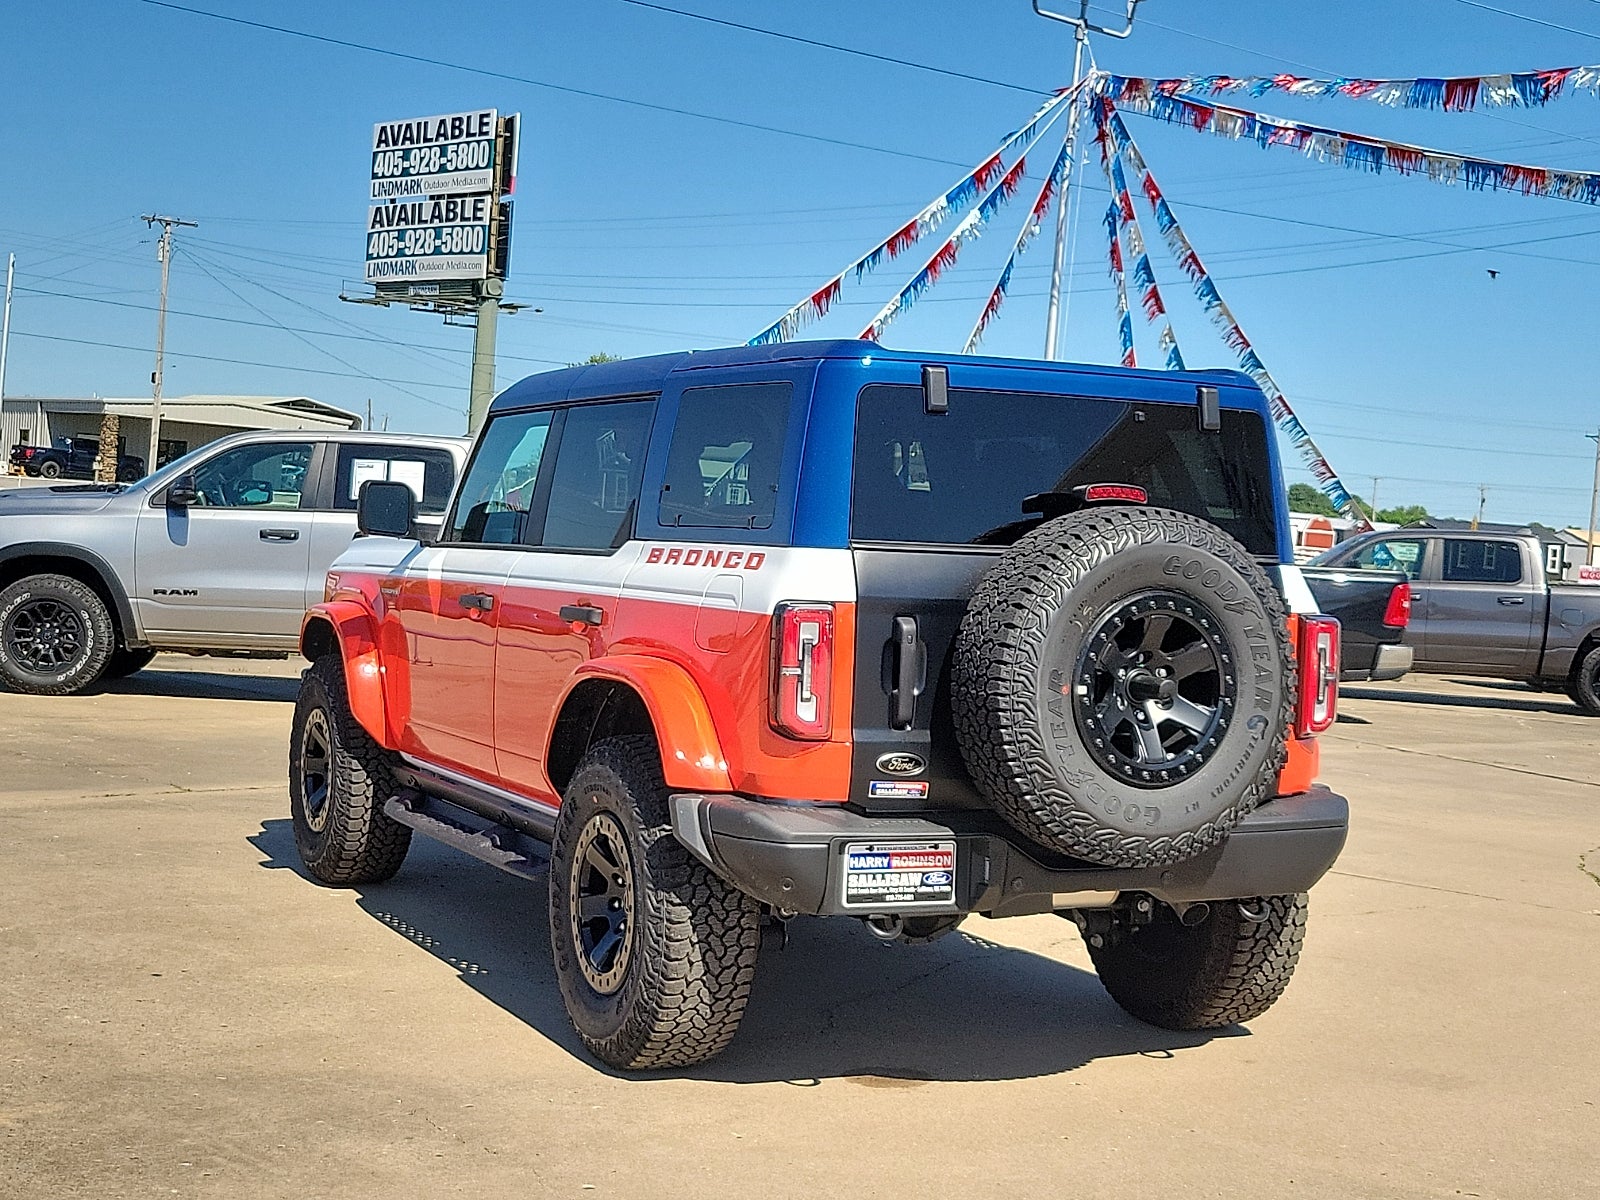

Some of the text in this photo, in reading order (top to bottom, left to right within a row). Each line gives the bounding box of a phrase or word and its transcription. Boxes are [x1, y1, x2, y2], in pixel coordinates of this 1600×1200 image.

[376, 113, 491, 148] AVAILABLE
[373, 141, 490, 177] 405-928-5800
[372, 176, 488, 198] LINDMARK Outdoor Media.com
[371, 199, 485, 230] AVAILABLE
[368, 226, 484, 258] 405-928-5800
[367, 260, 482, 279] LINDMARK Outdoor Media.com
[646, 548, 766, 570] BRONCO
[153, 588, 199, 596] RAM
[57, 610, 94, 681] GOODYEAR
[1163, 555, 1271, 712] GOODYEAR
[1047, 668, 1161, 826] GOODYEAR
[887, 757, 915, 771] Ford
[1211, 735, 1259, 798] TERRITORY
[849, 854, 952, 869] HARRY ROBINSON
[848, 872, 923, 888] SALLISAW
